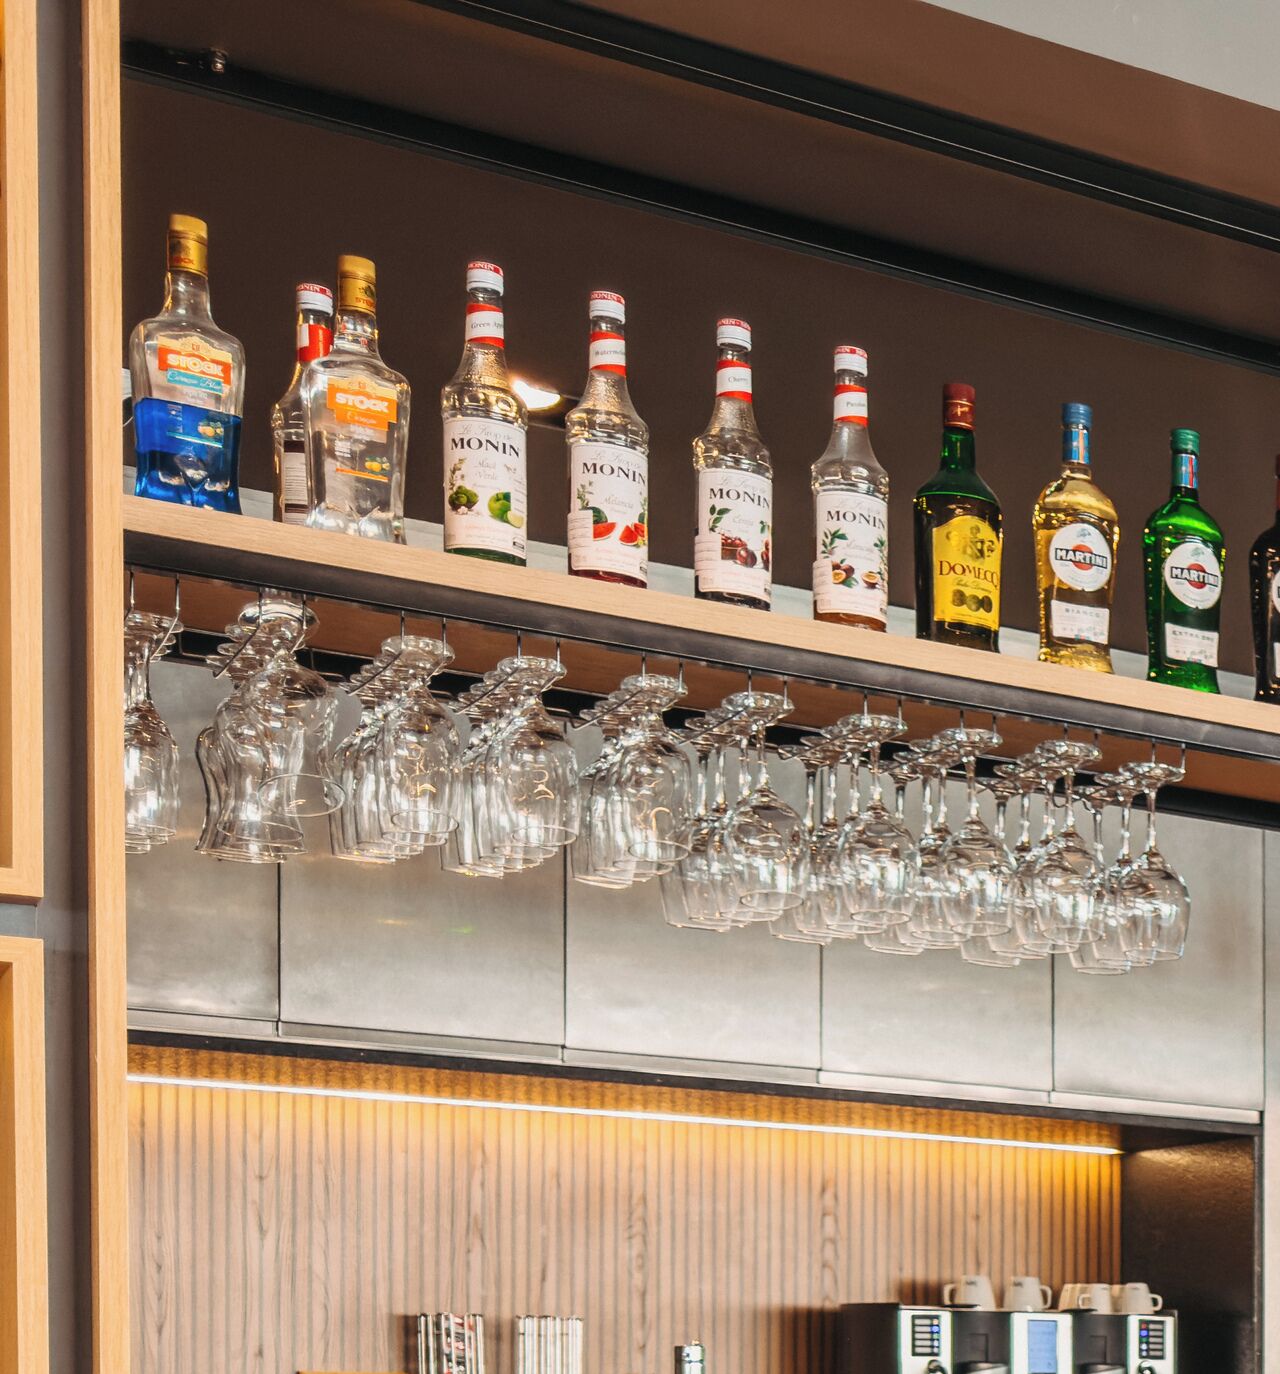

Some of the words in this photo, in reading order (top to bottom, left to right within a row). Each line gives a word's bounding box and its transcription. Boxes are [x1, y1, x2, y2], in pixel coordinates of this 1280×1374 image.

[167, 353, 224, 377] STOCK
[336, 392, 389, 413] STOCK
[451, 437, 519, 458] MONIN
[582, 462, 646, 485] MONIN
[709, 487, 770, 510] MONIN
[826, 510, 885, 531] MONIN
[1056, 548, 1107, 569] MARTINI
[938, 560, 999, 591] DOMECQ
[1172, 567, 1218, 587] MARTINI
